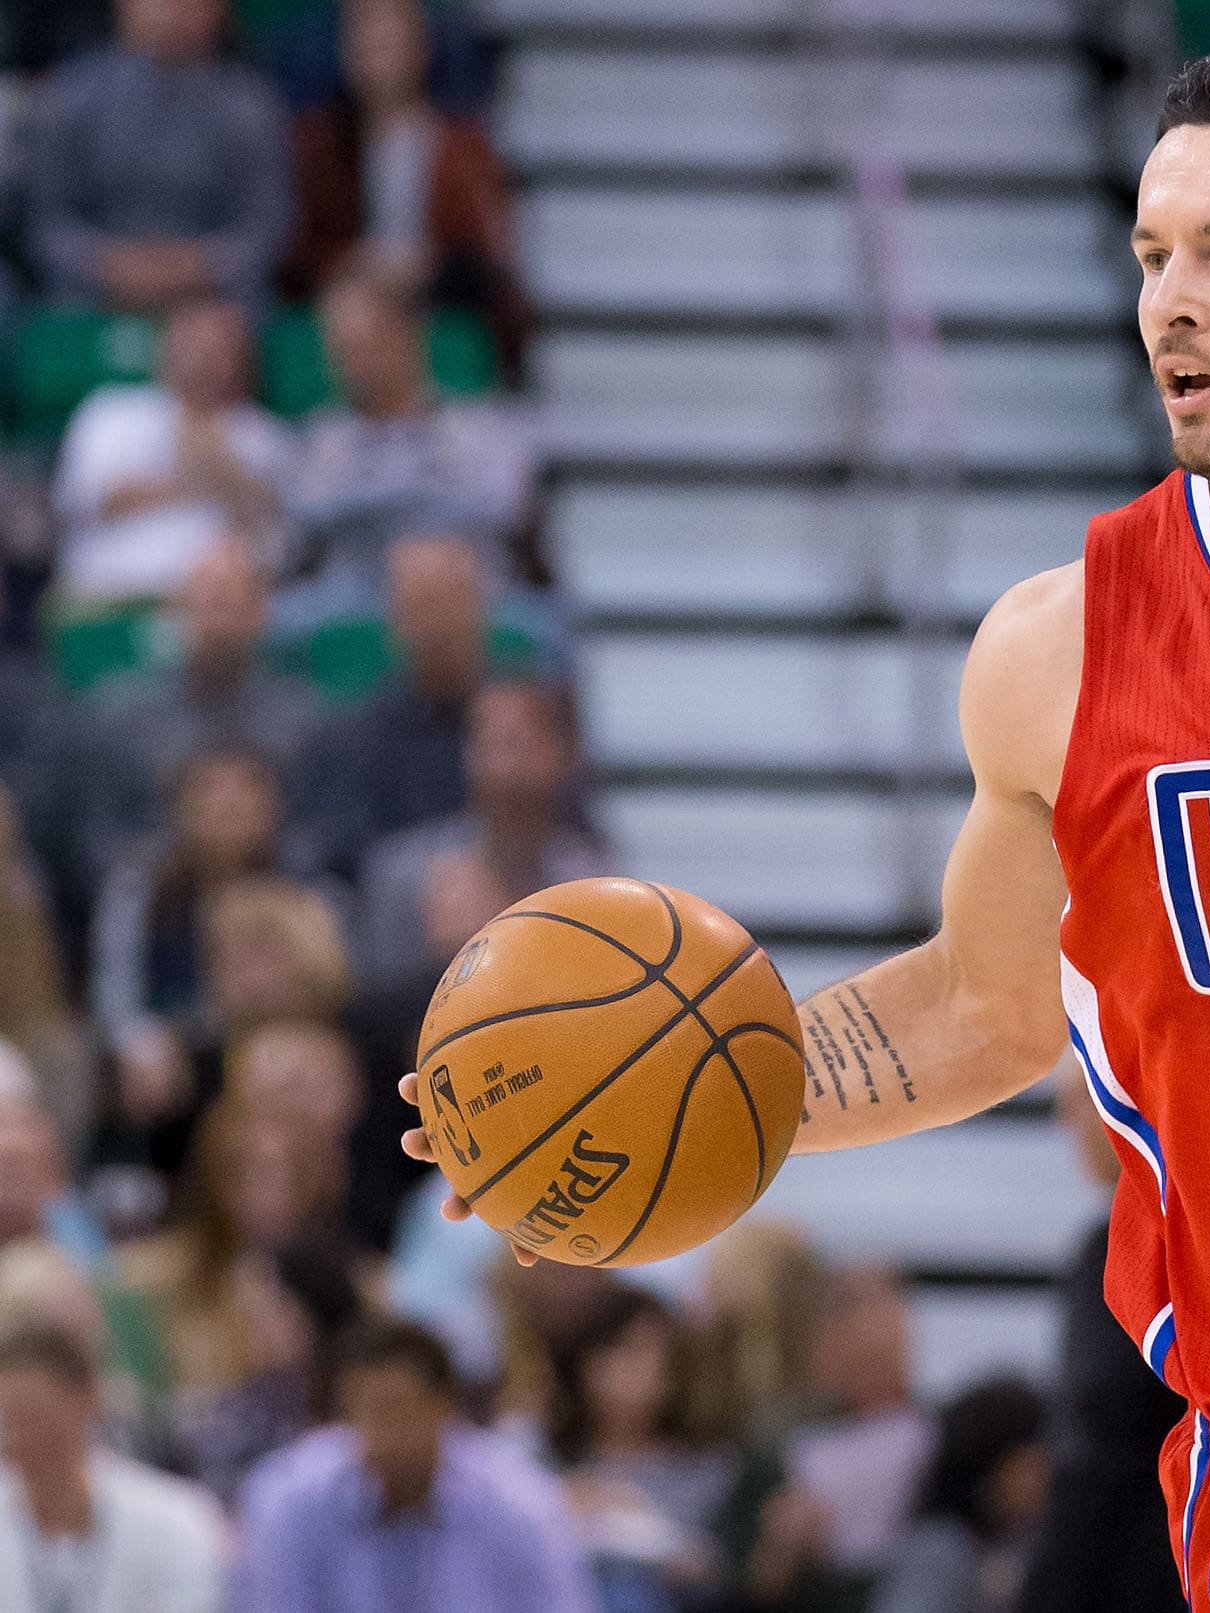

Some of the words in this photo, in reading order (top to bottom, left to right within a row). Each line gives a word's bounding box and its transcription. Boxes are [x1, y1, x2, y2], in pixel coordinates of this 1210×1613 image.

[504, 1064, 543, 1095] OFFICIAL
[465, 1095, 486, 1118] BALL
[483, 1083, 507, 1109] GAME
[501, 1128, 630, 1250] SPALD
